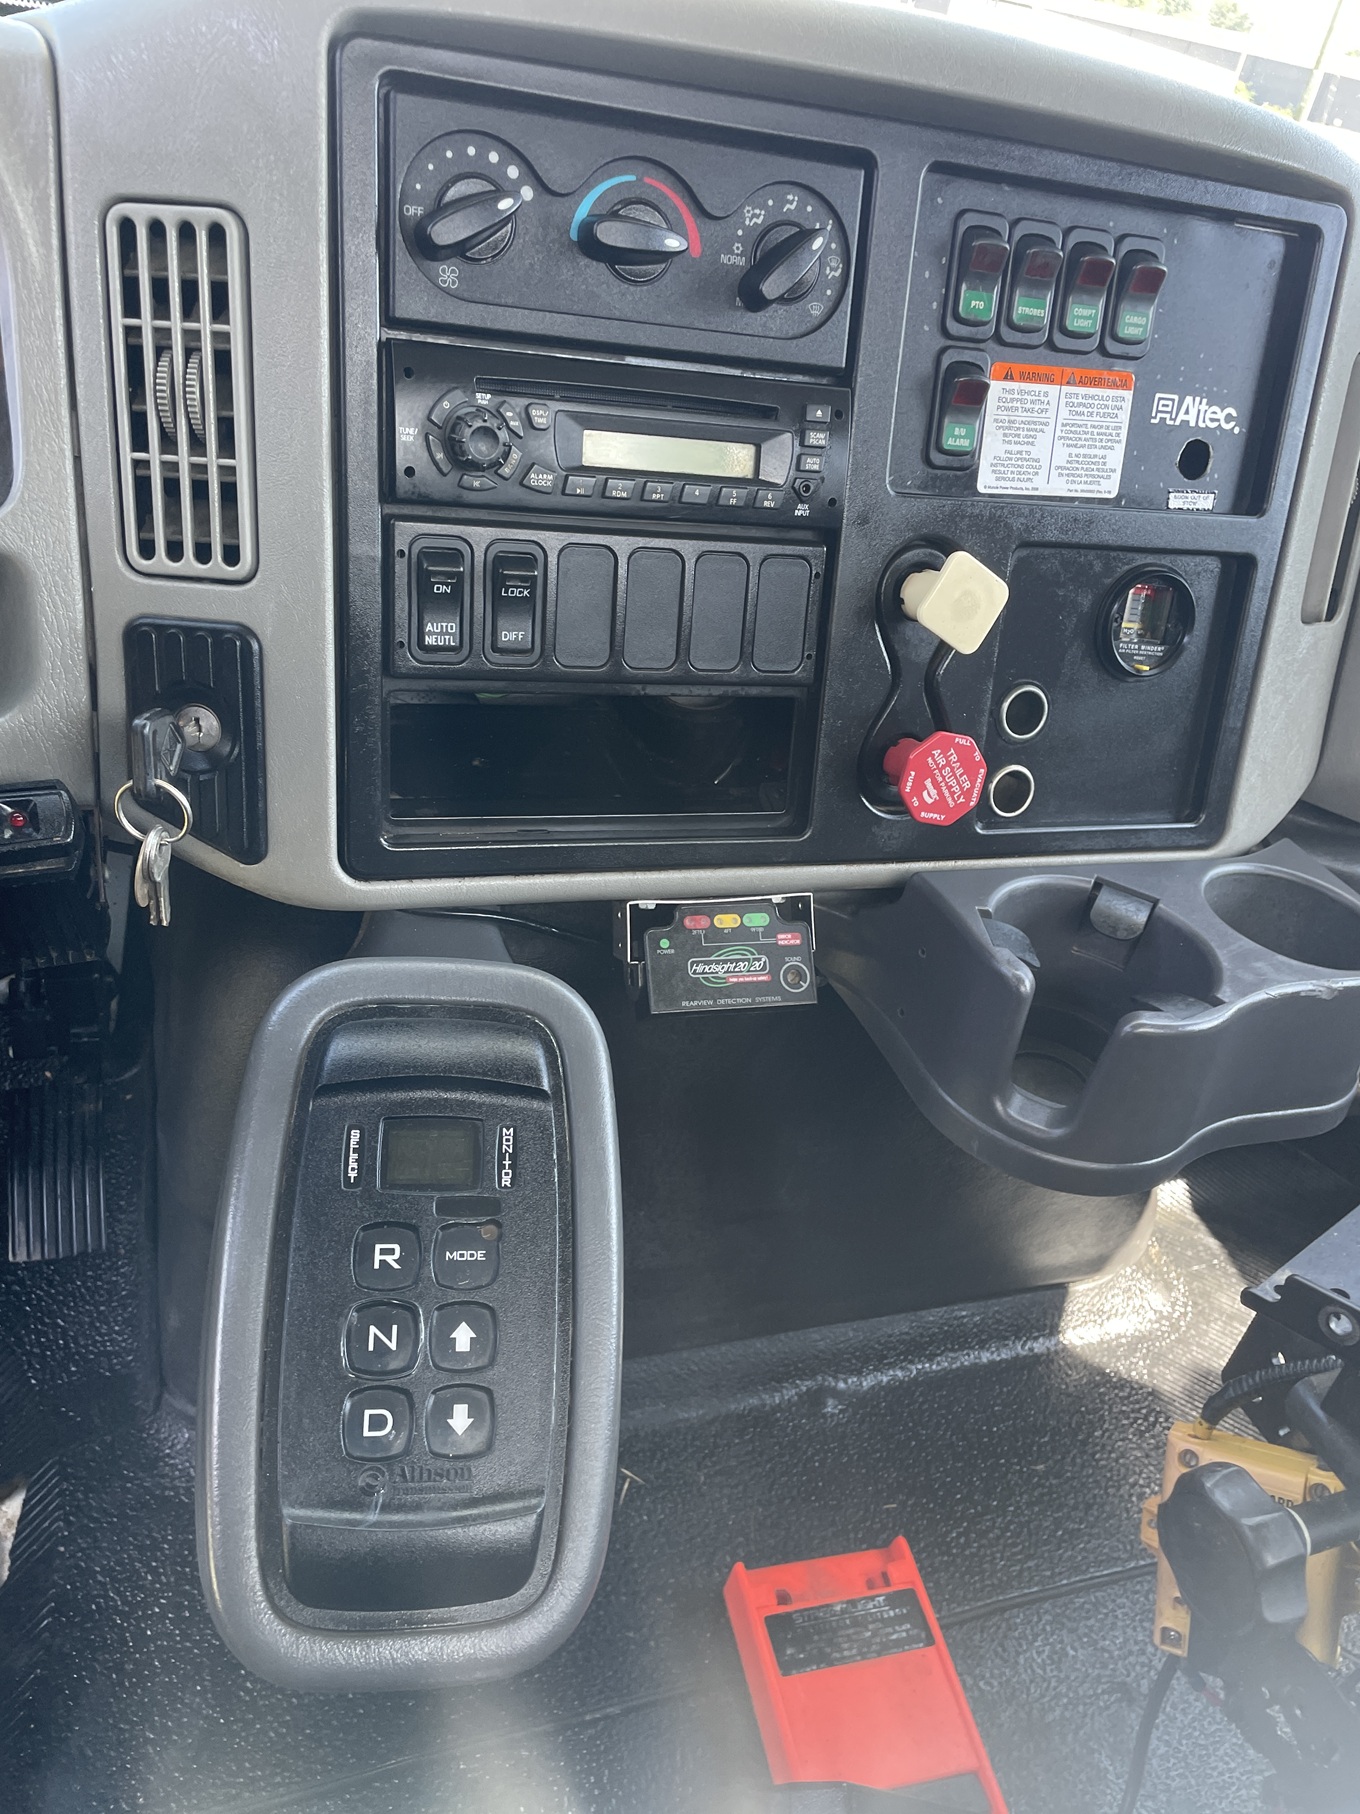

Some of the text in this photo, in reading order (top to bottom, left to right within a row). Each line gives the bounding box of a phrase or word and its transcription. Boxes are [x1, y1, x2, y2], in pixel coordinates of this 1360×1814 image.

[403, 204, 424, 216] OFF
[720, 254, 746, 266] NORM
[970, 300, 984, 310] PTO
[1018, 306, 1044, 318] STROBES
[1074, 308, 1096, 318] COMPT
[1074, 318, 1092, 328] LIGHT
[1125, 315, 1146, 325] CARGO
[1124, 326, 1143, 336] LIGHT
[1019, 370, 1055, 382] WARNING
[1078, 376, 1128, 388] ADVERTENCIA
[1017, 389, 1042, 397] VEHICLE
[1081, 394, 1110, 402] VEHICULO
[998, 397, 1028, 405] EQUIPPED
[1065, 401, 1095, 409] EQUIPADO
[399, 427, 418, 435] TUNE/
[947, 437, 970, 446] ALARM
[530, 472, 554, 480] ALARM
[434, 584, 451, 594] ON
[502, 588, 531, 597] LOCK
[426, 622, 456, 633] AUTO
[425, 635, 456, 646] NEUTL
[502, 632, 526, 641] DIFF
[973, 751, 980, 762] TO
[947, 748, 971, 791] TRAILER
[932, 749, 966, 804] AIR SUPPLY
[927, 757, 955, 808] NOT FOR PARKING
[969, 768, 984, 806] EVACUATE
[905, 771, 945, 820] PUSH TO SUPPLY
[691, 961, 734, 974] Hindsight
[348, 1129, 360, 1183] SELECT
[501, 1127, 514, 1187] MONITOR
[373, 1244, 402, 1270] R
[445, 1250, 486, 1261] MODE
[368, 1324, 398, 1351] N
[363, 1409, 393, 1437] D
